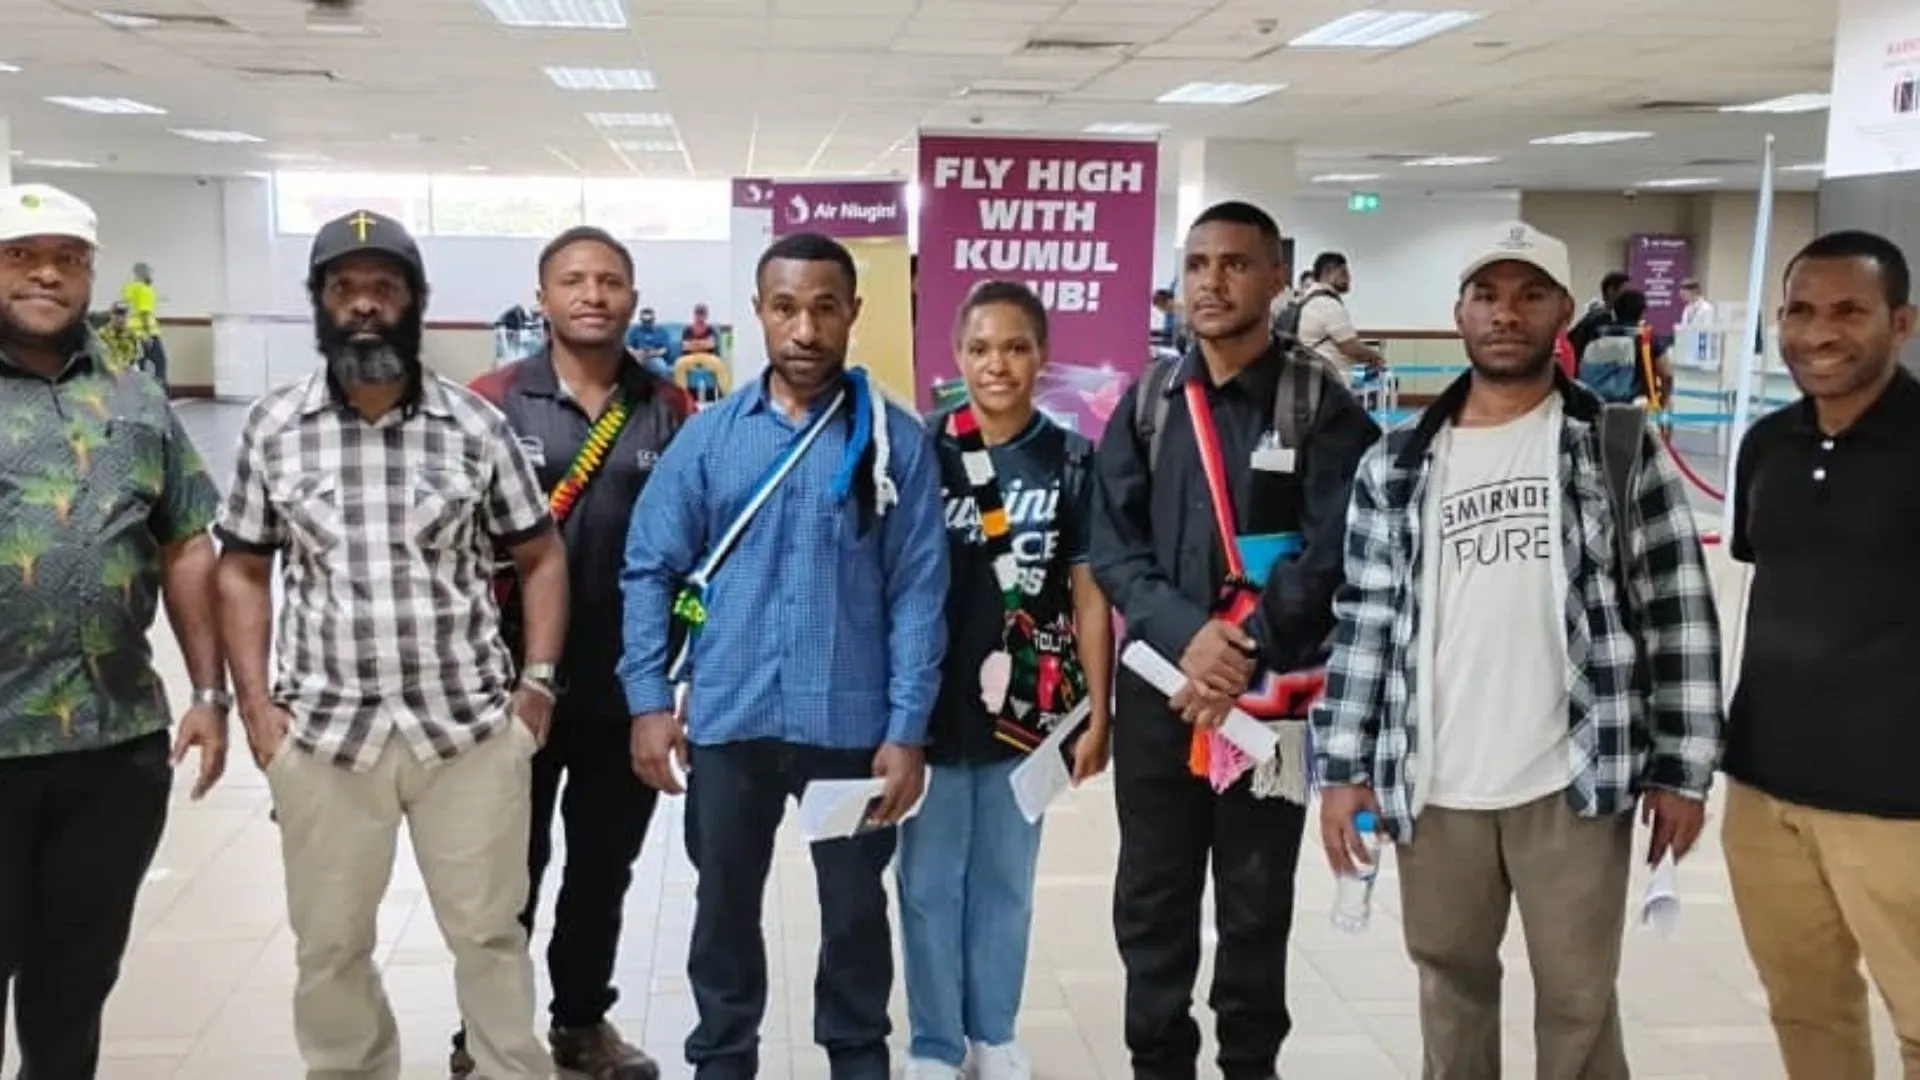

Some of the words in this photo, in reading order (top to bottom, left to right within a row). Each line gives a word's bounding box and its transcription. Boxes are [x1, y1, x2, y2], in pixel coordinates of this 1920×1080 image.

[934, 156, 1014, 190] FLY
[1027, 159, 1144, 193] HIGH
[813, 202, 838, 219] Air
[840, 202, 897, 224] Niugini
[979, 199, 1097, 232] WITH
[954, 238, 1119, 272] KUMUL
[1454, 526, 1549, 574] PURE
